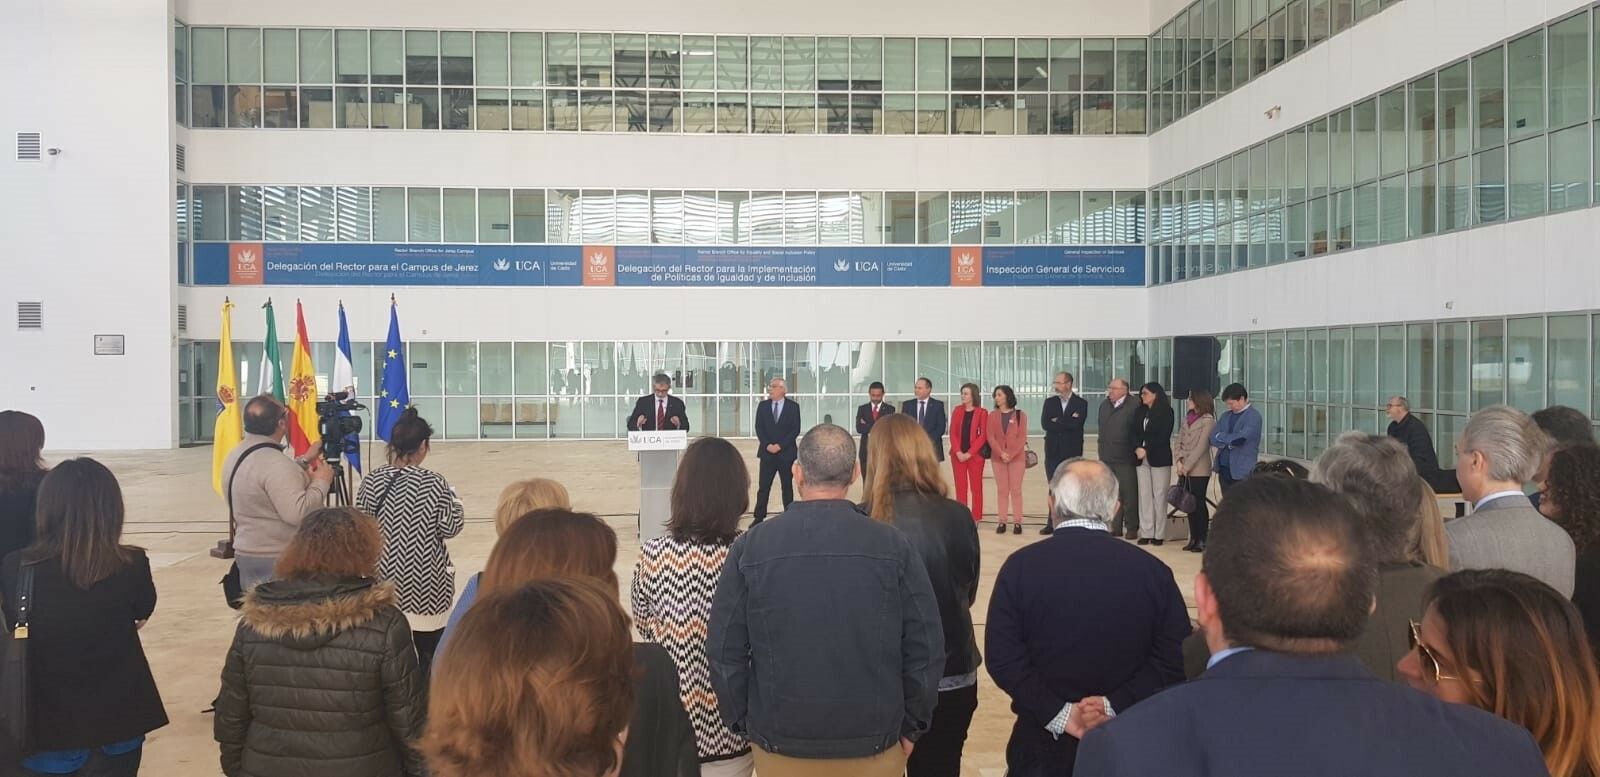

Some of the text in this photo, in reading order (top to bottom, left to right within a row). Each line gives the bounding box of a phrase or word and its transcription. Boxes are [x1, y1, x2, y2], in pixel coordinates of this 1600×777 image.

[267, 262, 479, 272] Delegación del Rector para el Campus de Jerez
[516, 260, 540, 270] UCA
[618, 264, 666, 274] Delegación
[668, 264, 682, 272] del
[684, 264, 713, 272] Rector
[716, 266, 736, 274] para
[748, 265, 816, 274] Implementación
[855, 261, 878, 272] UCA
[986, 264, 1124, 274] Inspección General de Servicios
[651, 273, 662, 281] de
[704, 273, 714, 281] de
[718, 274, 754, 282] Igualdad
